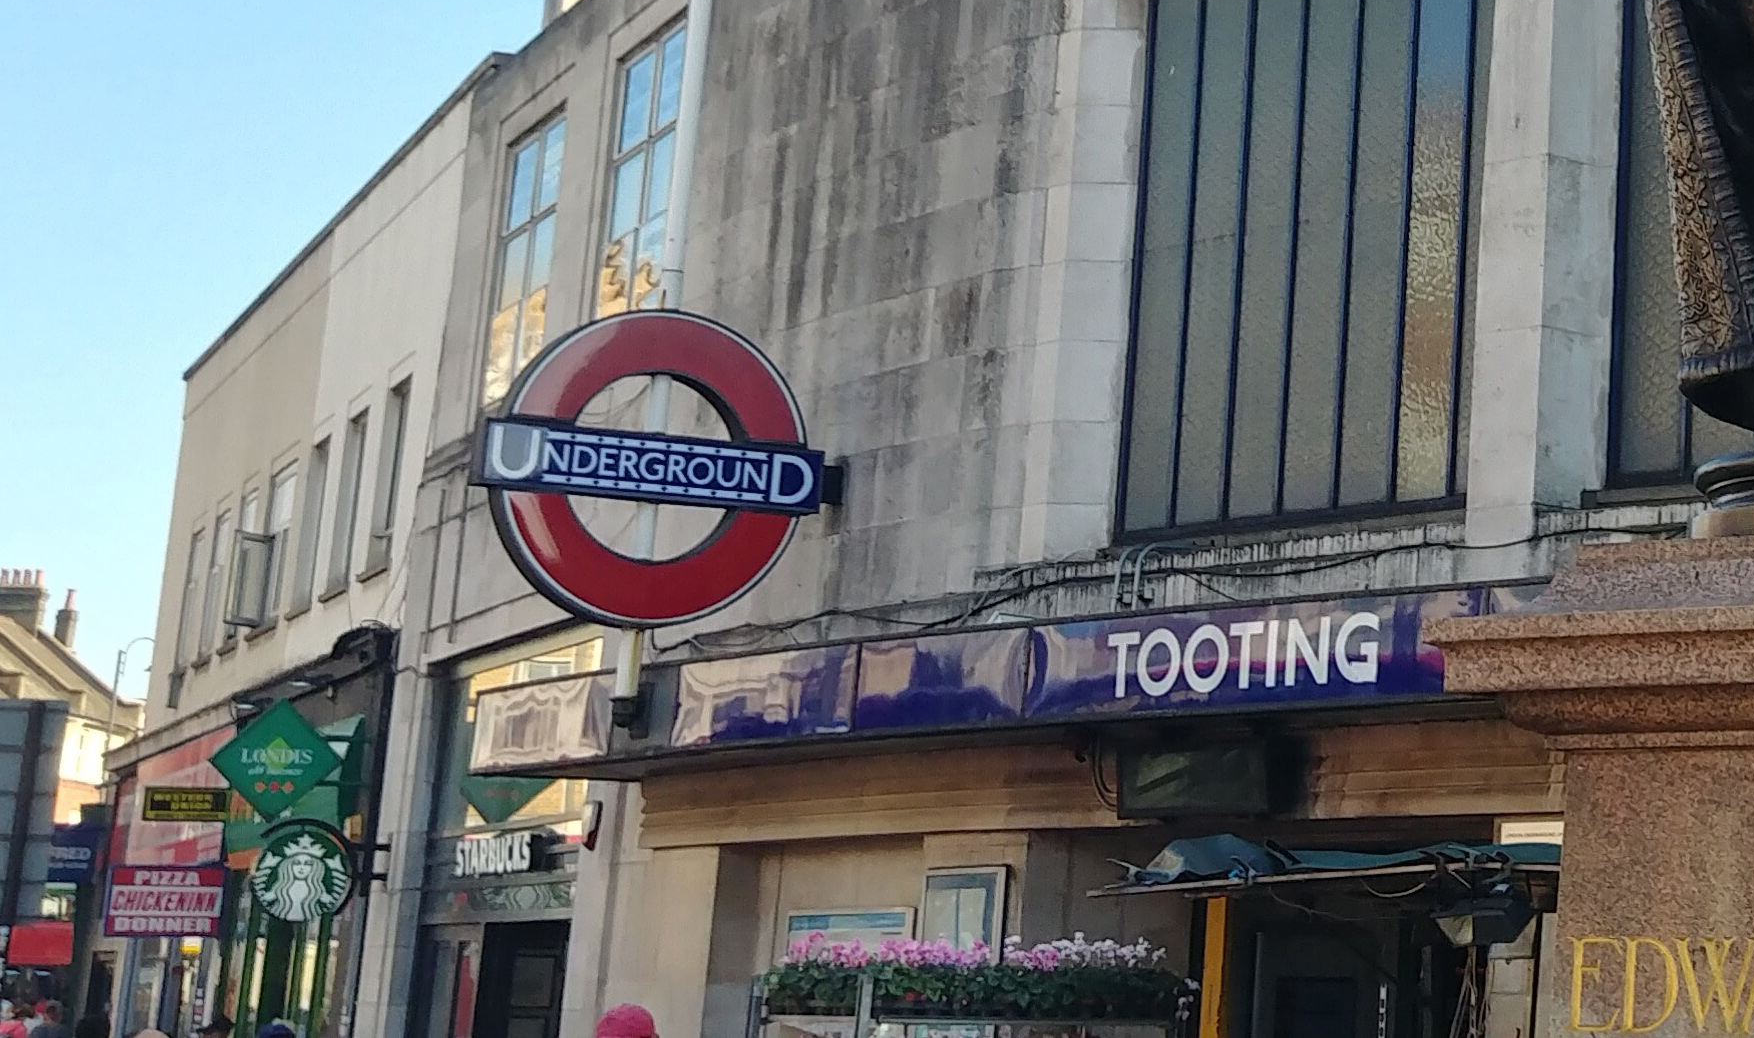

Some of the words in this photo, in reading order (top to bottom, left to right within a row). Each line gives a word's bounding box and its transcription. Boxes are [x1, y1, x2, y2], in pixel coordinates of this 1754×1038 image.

[492, 424, 814, 504] UNDERGROUND
[1107, 612, 1381, 699] TOOTING
[241, 748, 313, 765] LONDIS
[454, 832, 532, 878] STARBUCKS
[133, 870, 200, 886] PIZZA
[113, 916, 212, 933] DONNER
